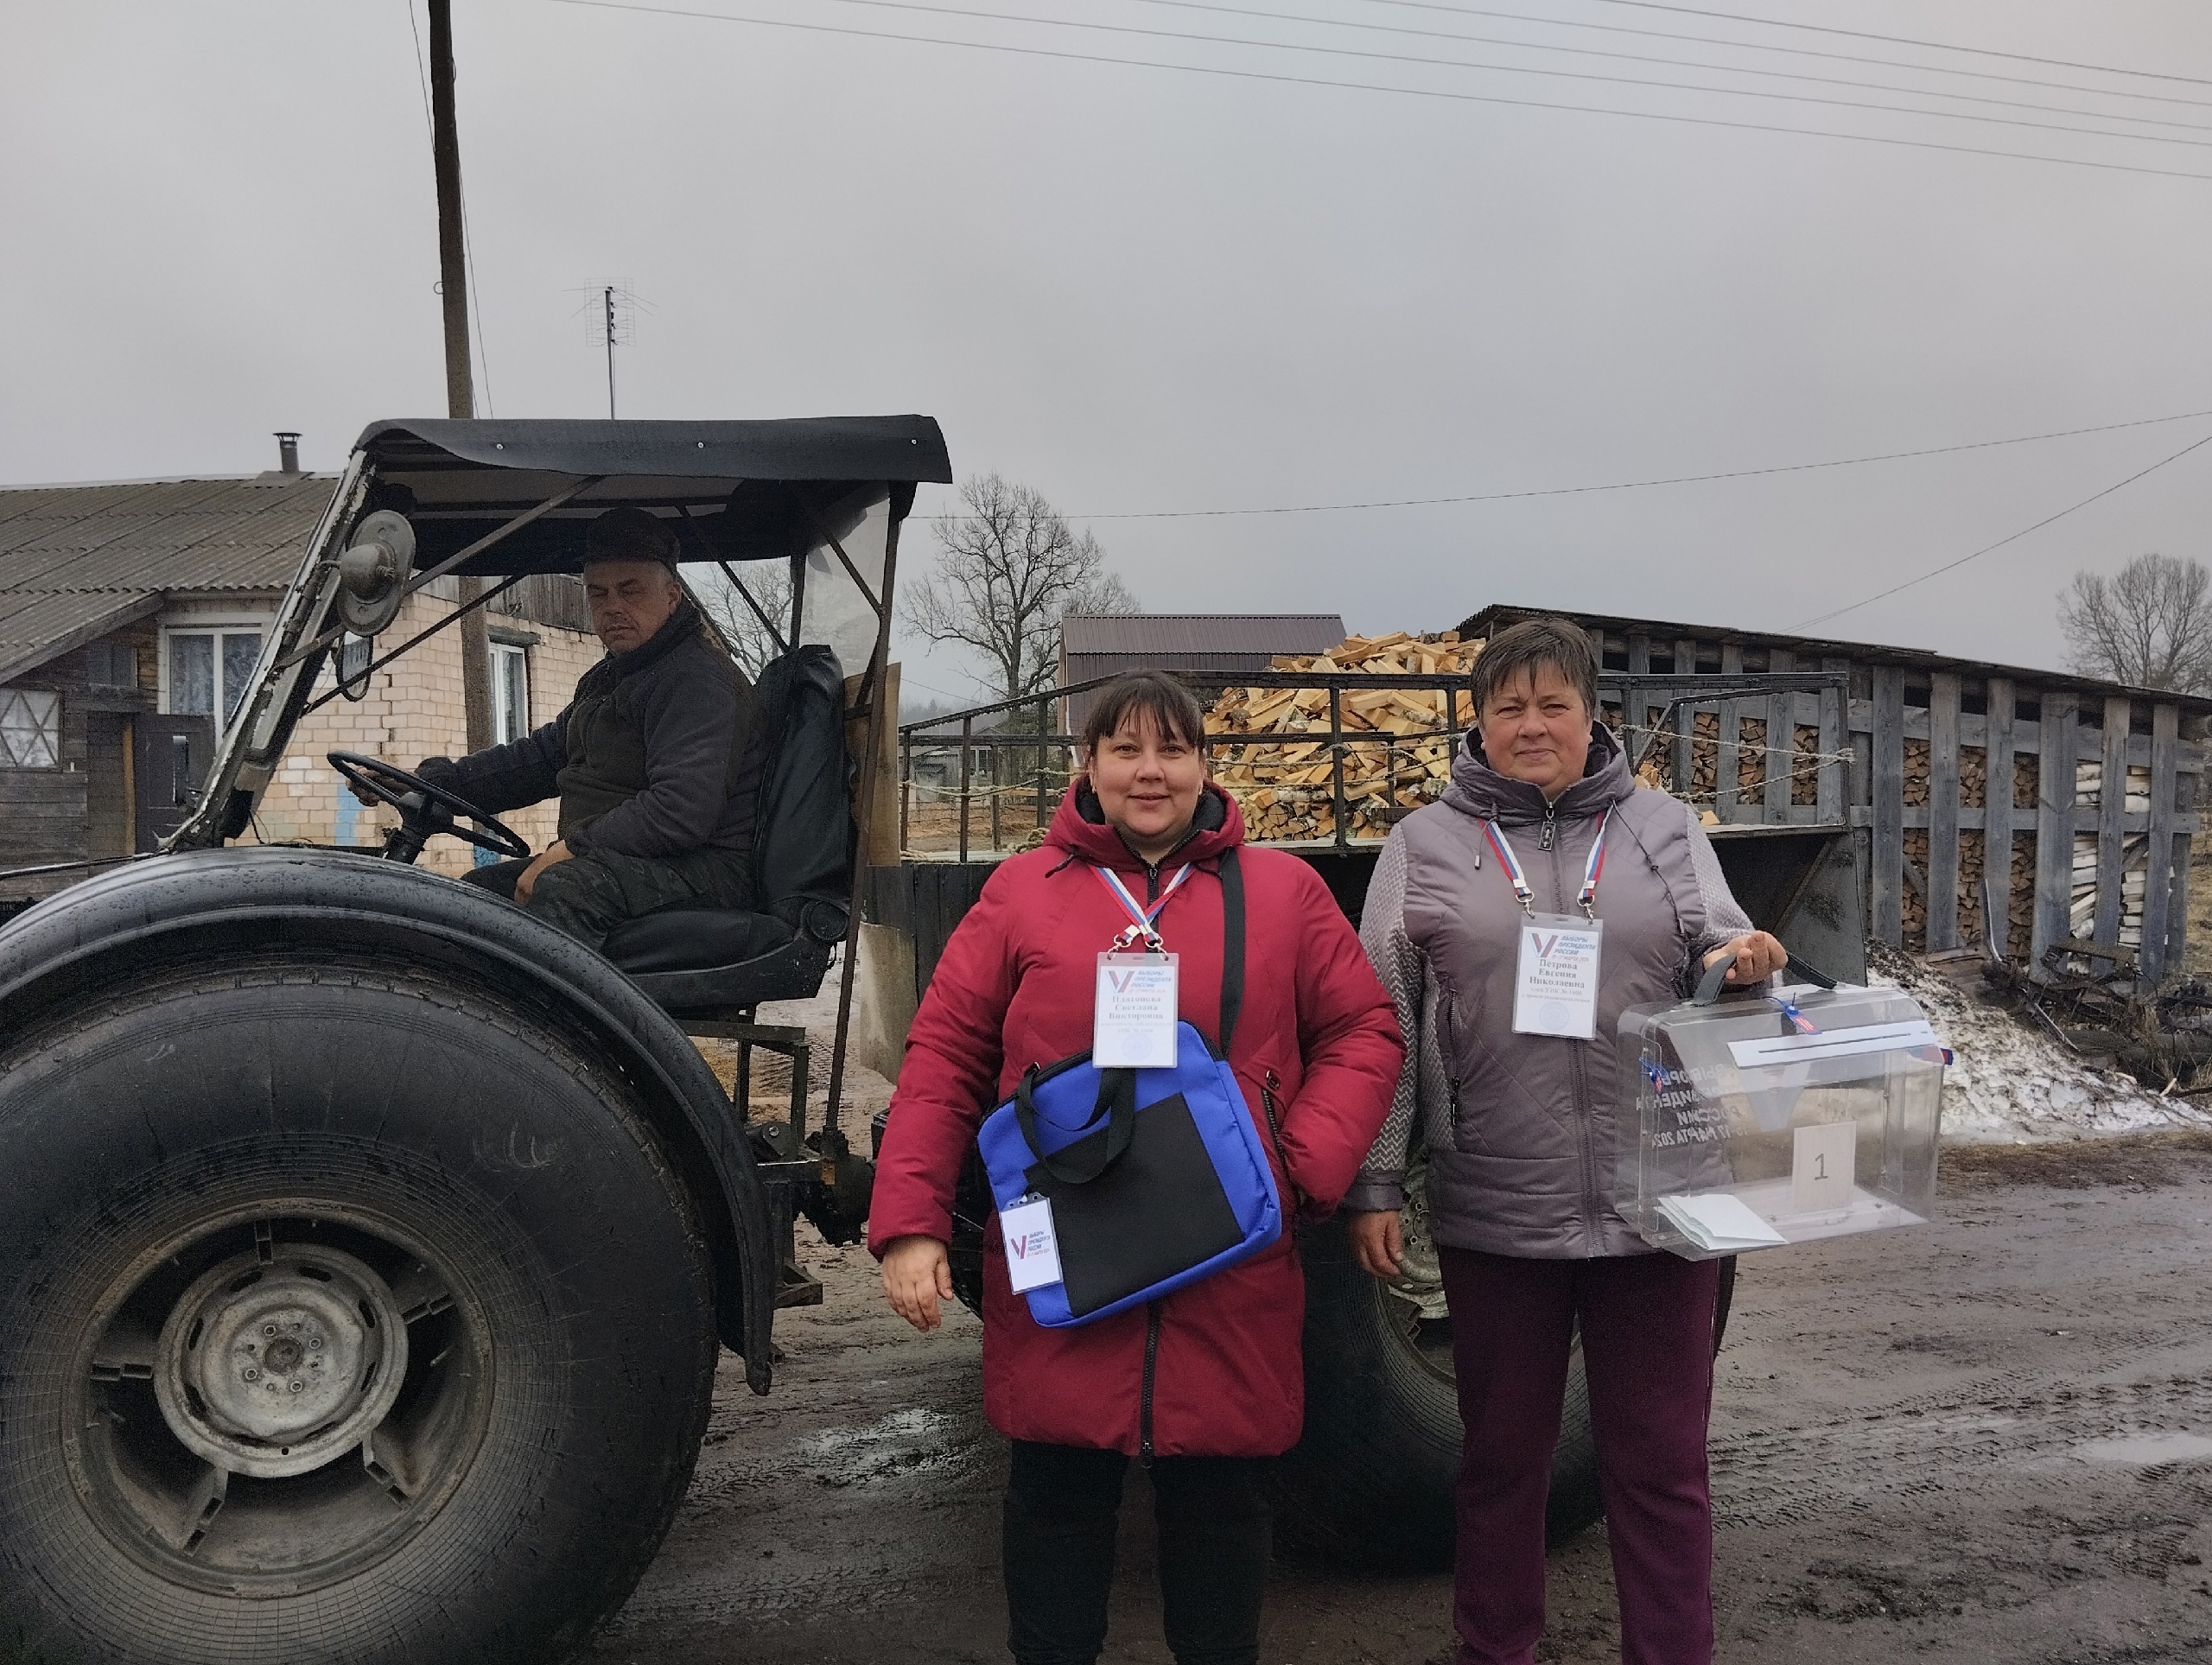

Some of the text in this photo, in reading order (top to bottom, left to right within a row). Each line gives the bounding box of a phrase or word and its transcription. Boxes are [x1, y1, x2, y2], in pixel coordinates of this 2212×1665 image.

[1557, 942, 1597, 950] ПРЕЗИДЕНТА
[1540, 959, 1578, 969] Петрова
[1538, 969, 1577, 978] Евгения
[1529, 976, 1586, 988] Николаевна
[1814, 1153, 1829, 1181] 1
